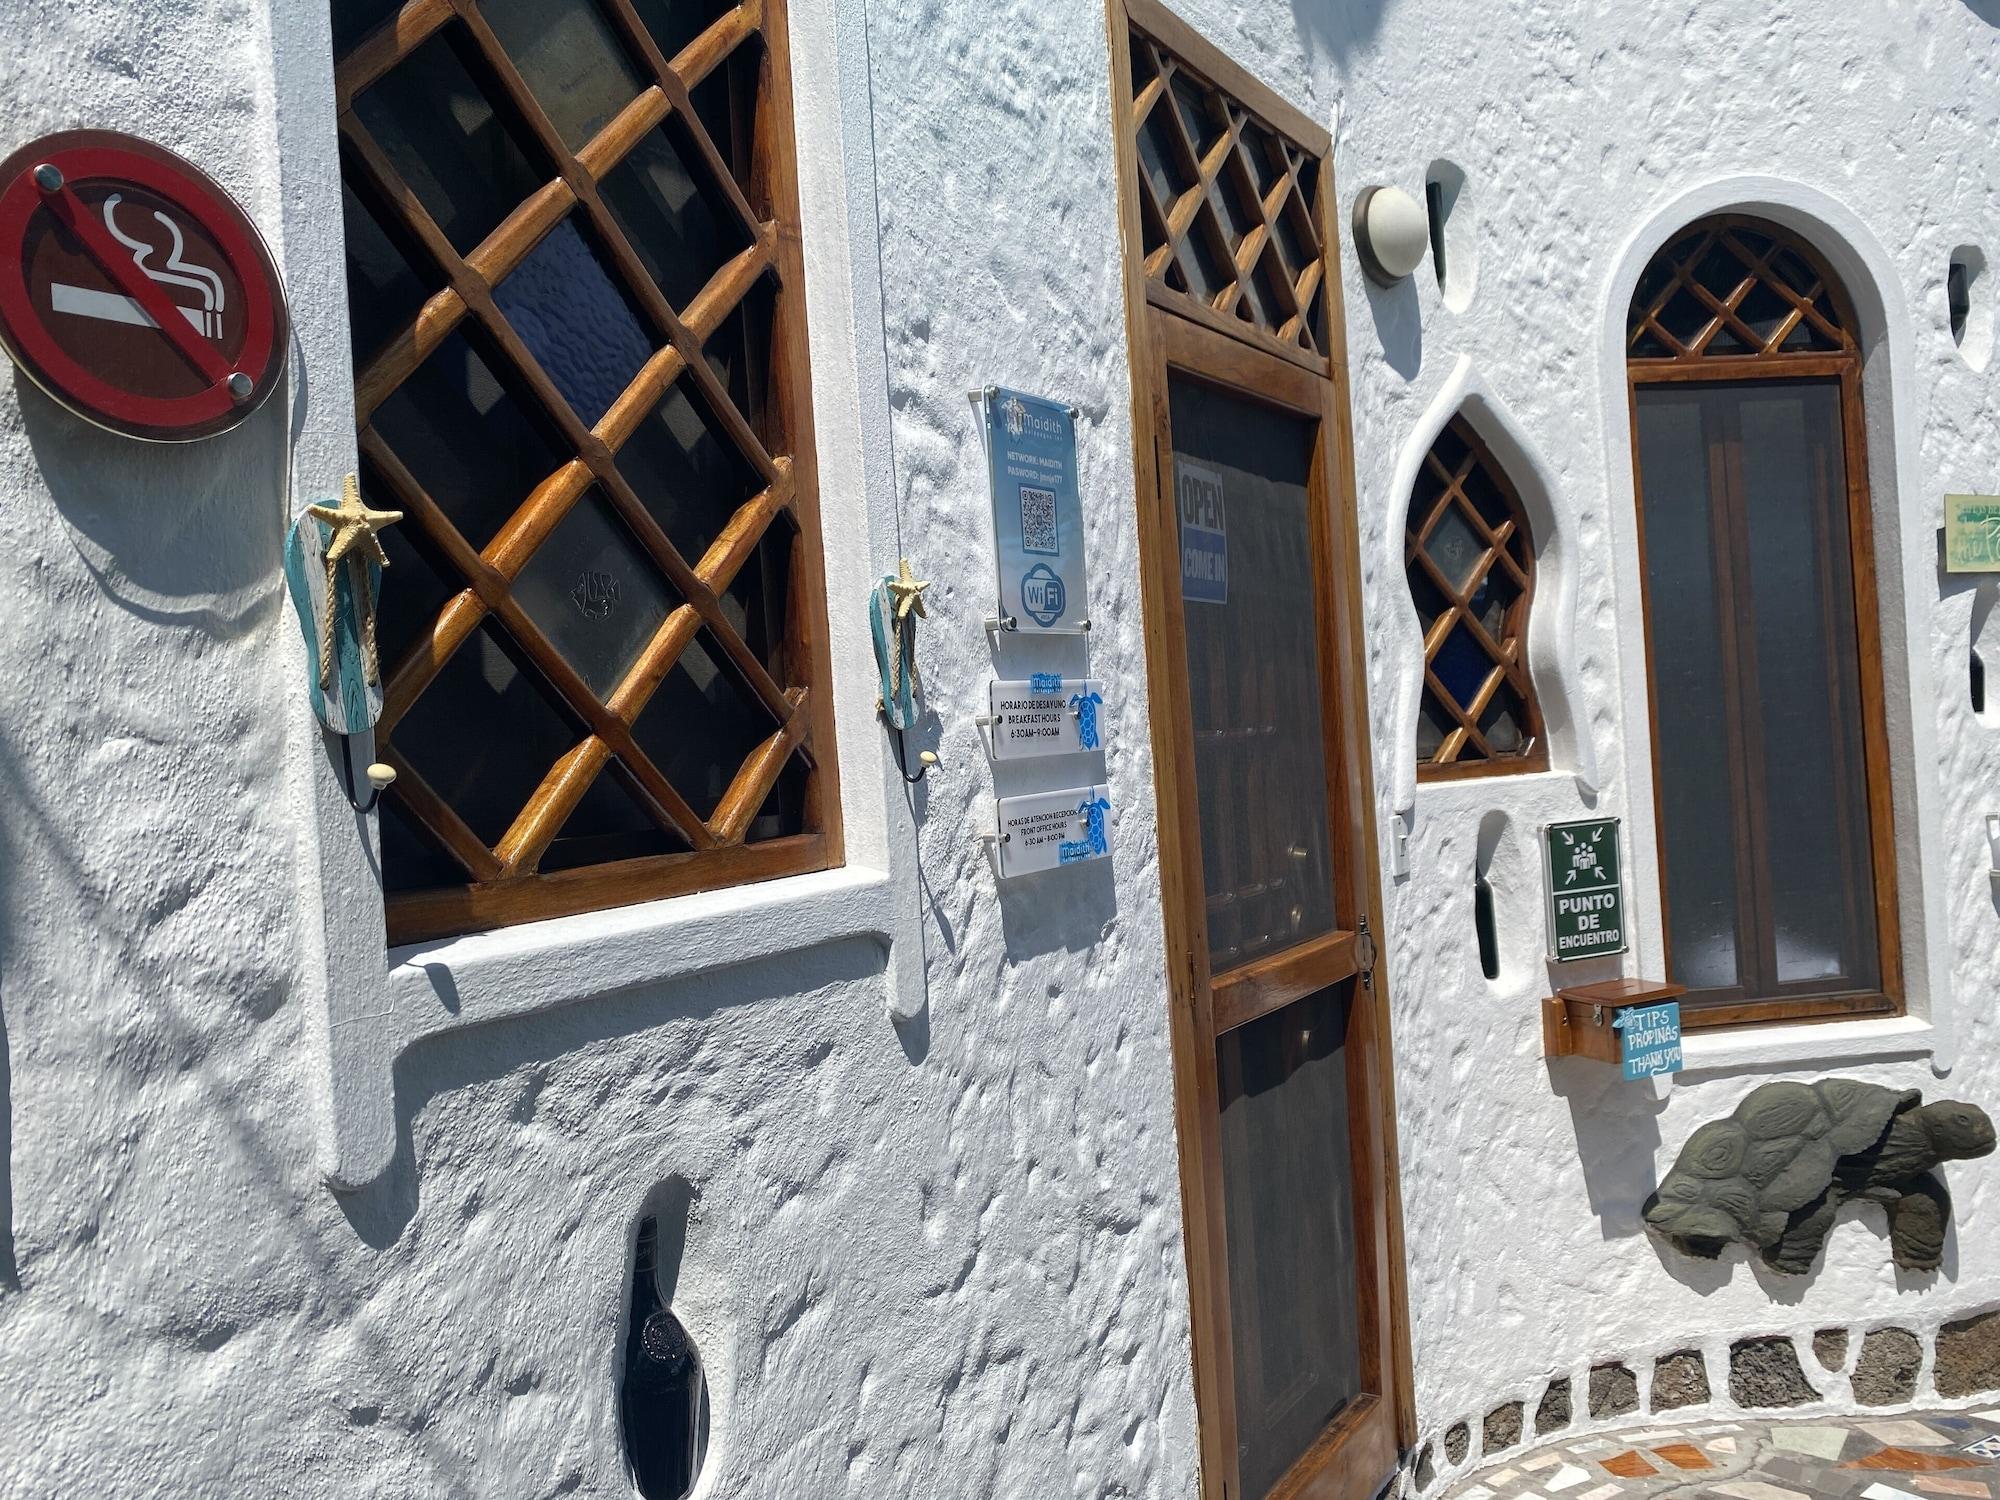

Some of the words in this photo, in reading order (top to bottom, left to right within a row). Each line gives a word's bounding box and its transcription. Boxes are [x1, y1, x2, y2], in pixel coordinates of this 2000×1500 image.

[1182, 474, 1225, 530] OPEN
[1184, 548, 1214, 581] COME
[1215, 552, 1225, 583] IN
[1000, 700, 1028, 710] HORARIO
[1028, 700, 1035, 710] DE
[1036, 700, 1067, 709] DESAYUNO
[1008, 714, 1041, 724] BREAKFAST
[1041, 713, 1061, 723] HOURS
[1008, 817, 1024, 827] HORAS
[1024, 816, 1030, 825] DE
[1021, 827, 1036, 836] FRONT
[1036, 824, 1052, 833] OFFICE
[1052, 821, 1068, 830] HOURS
[1559, 892, 1615, 915] PUNTO
[1578, 913, 1600, 931] DE
[1559, 929, 1620, 950] ENCUENTRO
[1634, 1010, 1670, 1031] TIPS
[1627, 1025, 1679, 1051] PROPINAS
[1628, 1050, 1664, 1075] THANK
